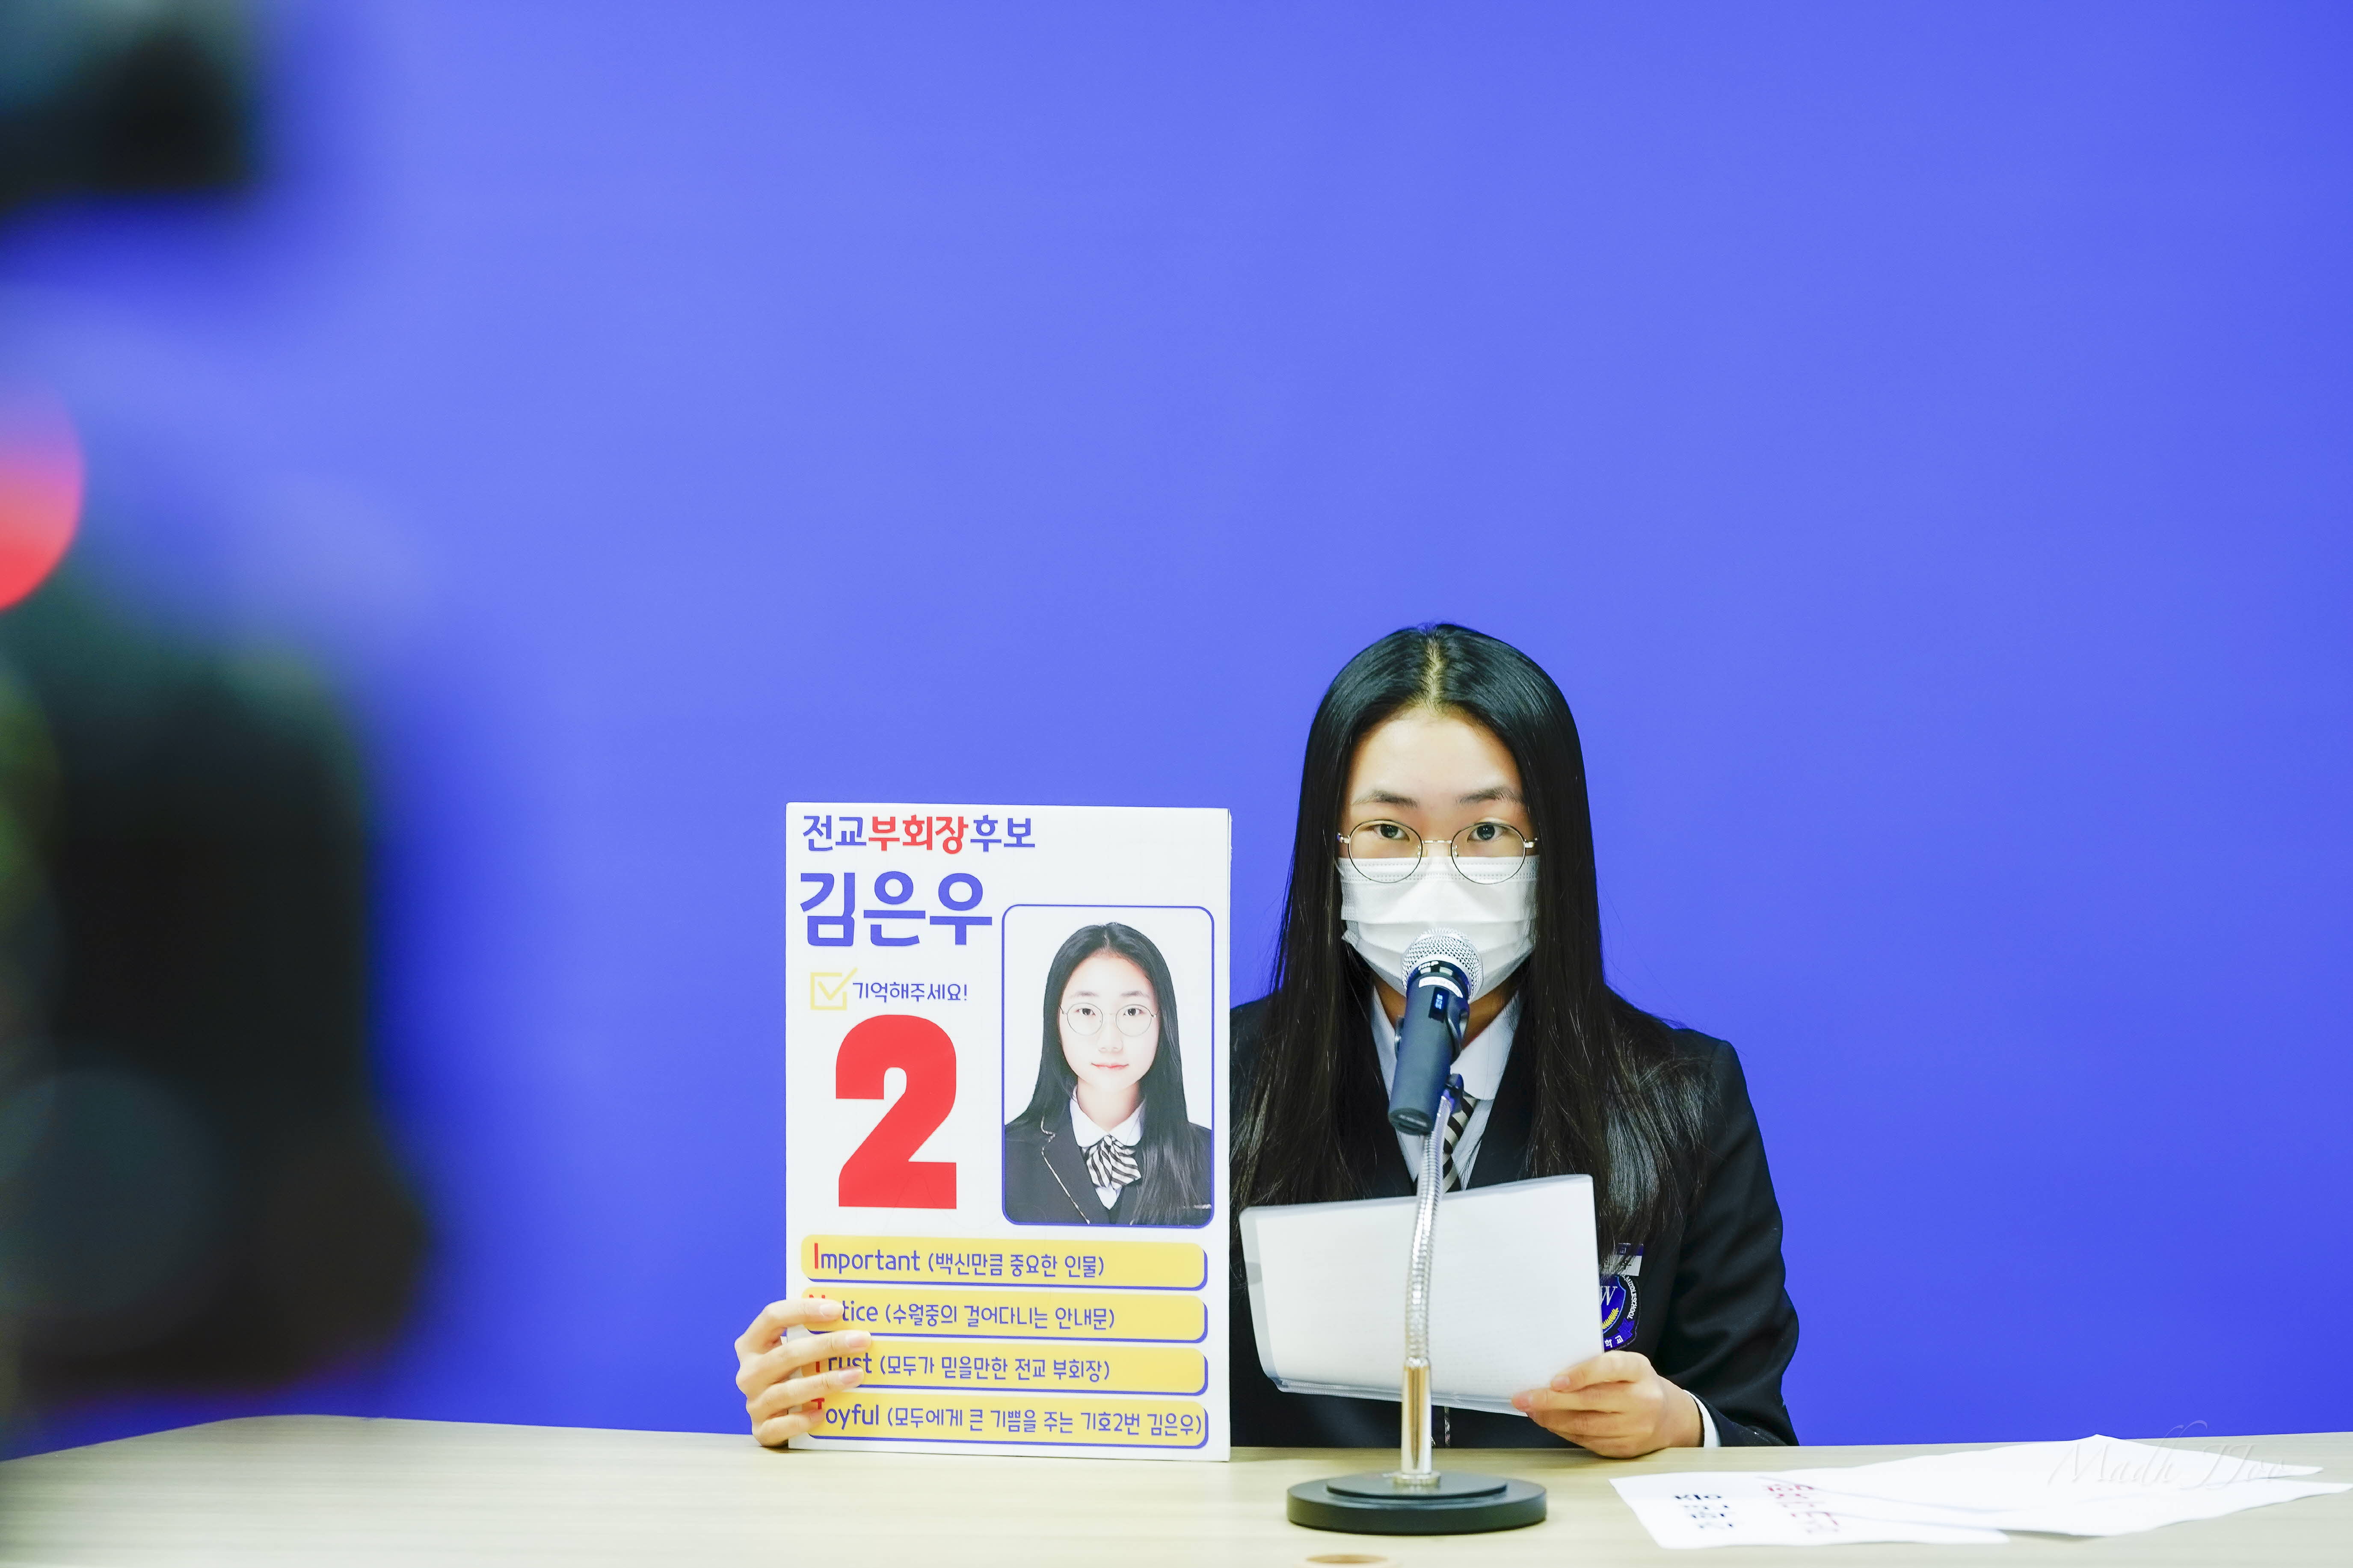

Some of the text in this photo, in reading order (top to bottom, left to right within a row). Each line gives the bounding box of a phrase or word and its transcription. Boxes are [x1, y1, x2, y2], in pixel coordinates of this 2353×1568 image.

[800, 871, 993, 947] 김은우
[852, 981, 967, 1003] 기억해주세요!
[836, 1015, 957, 1209] 2
[814, 1243, 1104, 1278] Important (백신만큼 중요한 인물)
[886, 1303, 957, 1327] (수월중의
[964, 1305, 1047, 1329] 걸어다니는
[1055, 1307, 1114, 1331] 안내문)
[880, 1356, 934, 1376] (모두가
[942, 1356, 1008, 1380] 믿을만한
[1015, 1358, 1045, 1381] 전교
[1054, 1360, 1109, 1382] 부회장)
[888, 1408, 962, 1428] (모두에게
[970, 1409, 983, 1432] 큰
[991, 1410, 1036, 1433] 기쁨을
[1045, 1411, 1073, 1434] 주는
[1081, 1411, 1140, 1435] 기호2번
[1147, 1413, 1201, 1436] 김은우)
